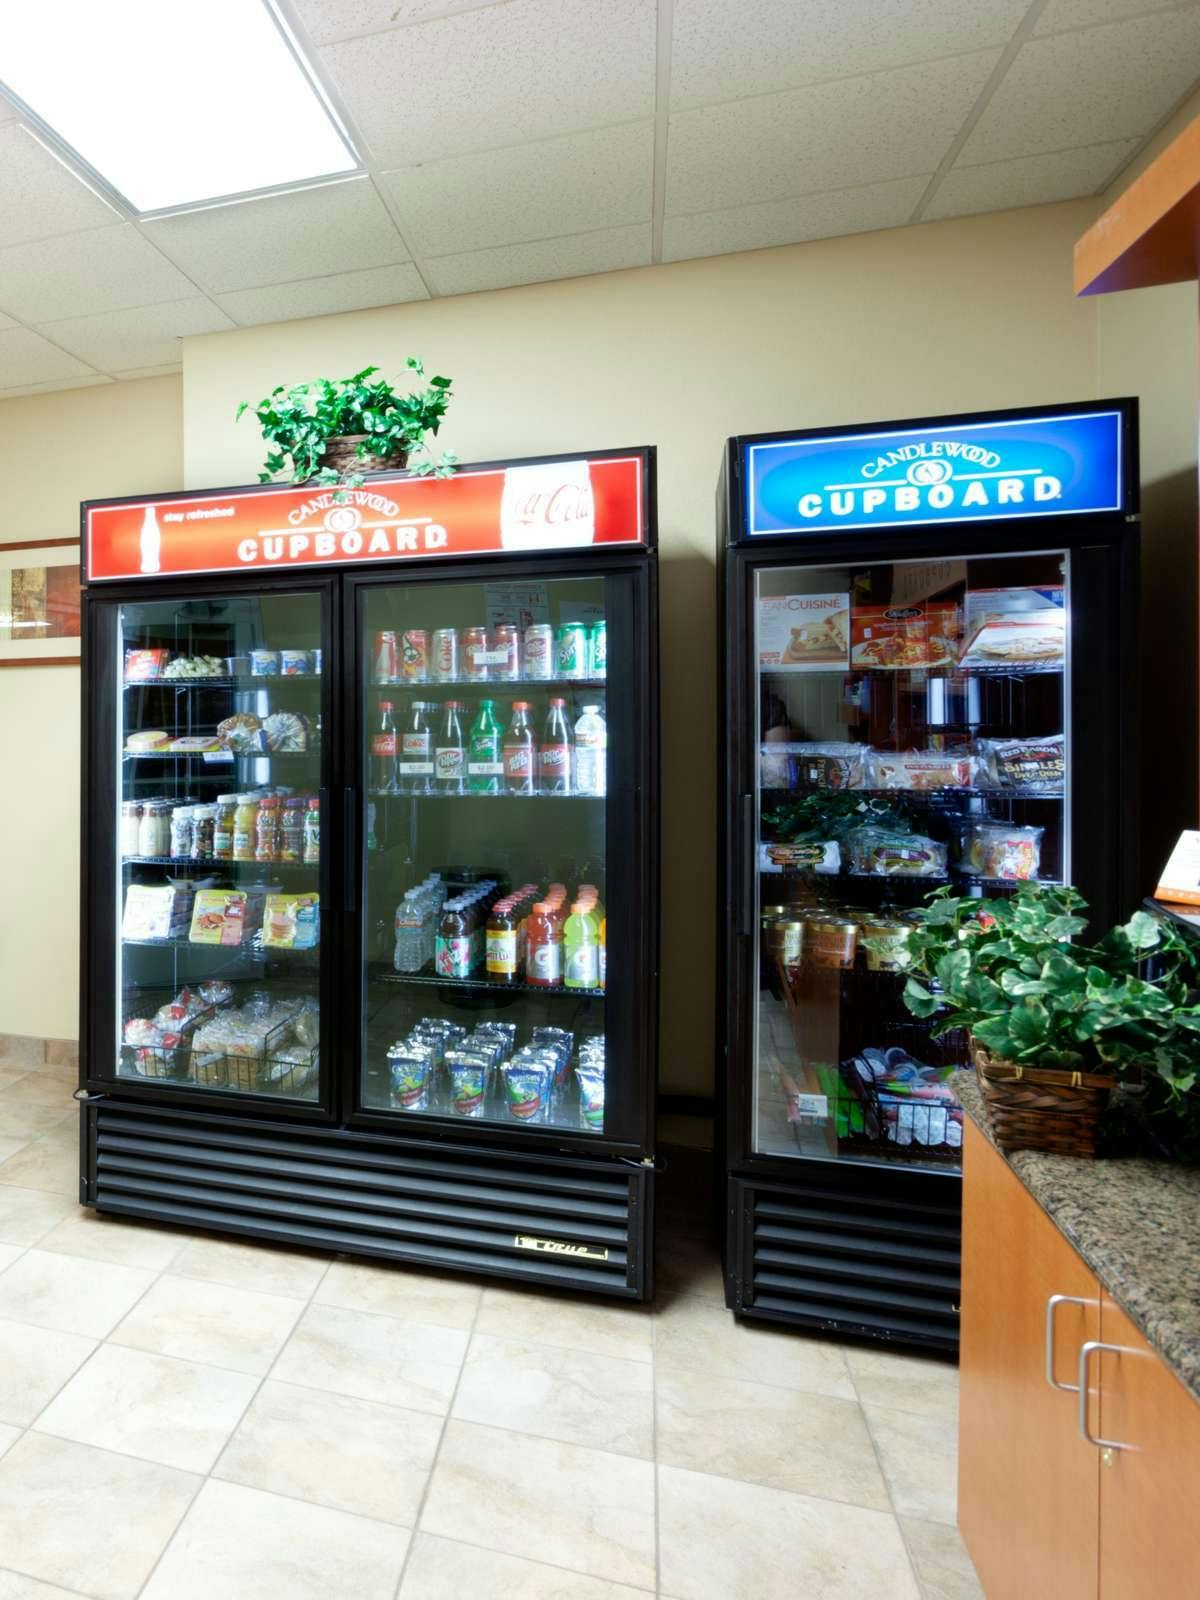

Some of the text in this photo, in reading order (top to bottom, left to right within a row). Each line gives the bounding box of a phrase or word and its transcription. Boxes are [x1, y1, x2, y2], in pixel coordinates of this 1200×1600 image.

[861, 441, 1001, 478] CANDLEWOOD
[163, 506, 236, 523] stay refreshed
[798, 476, 1062, 518] CUPBOARD
[237, 524, 447, 563] CUPBOARD
[787, 598, 841, 611] CUISINE
